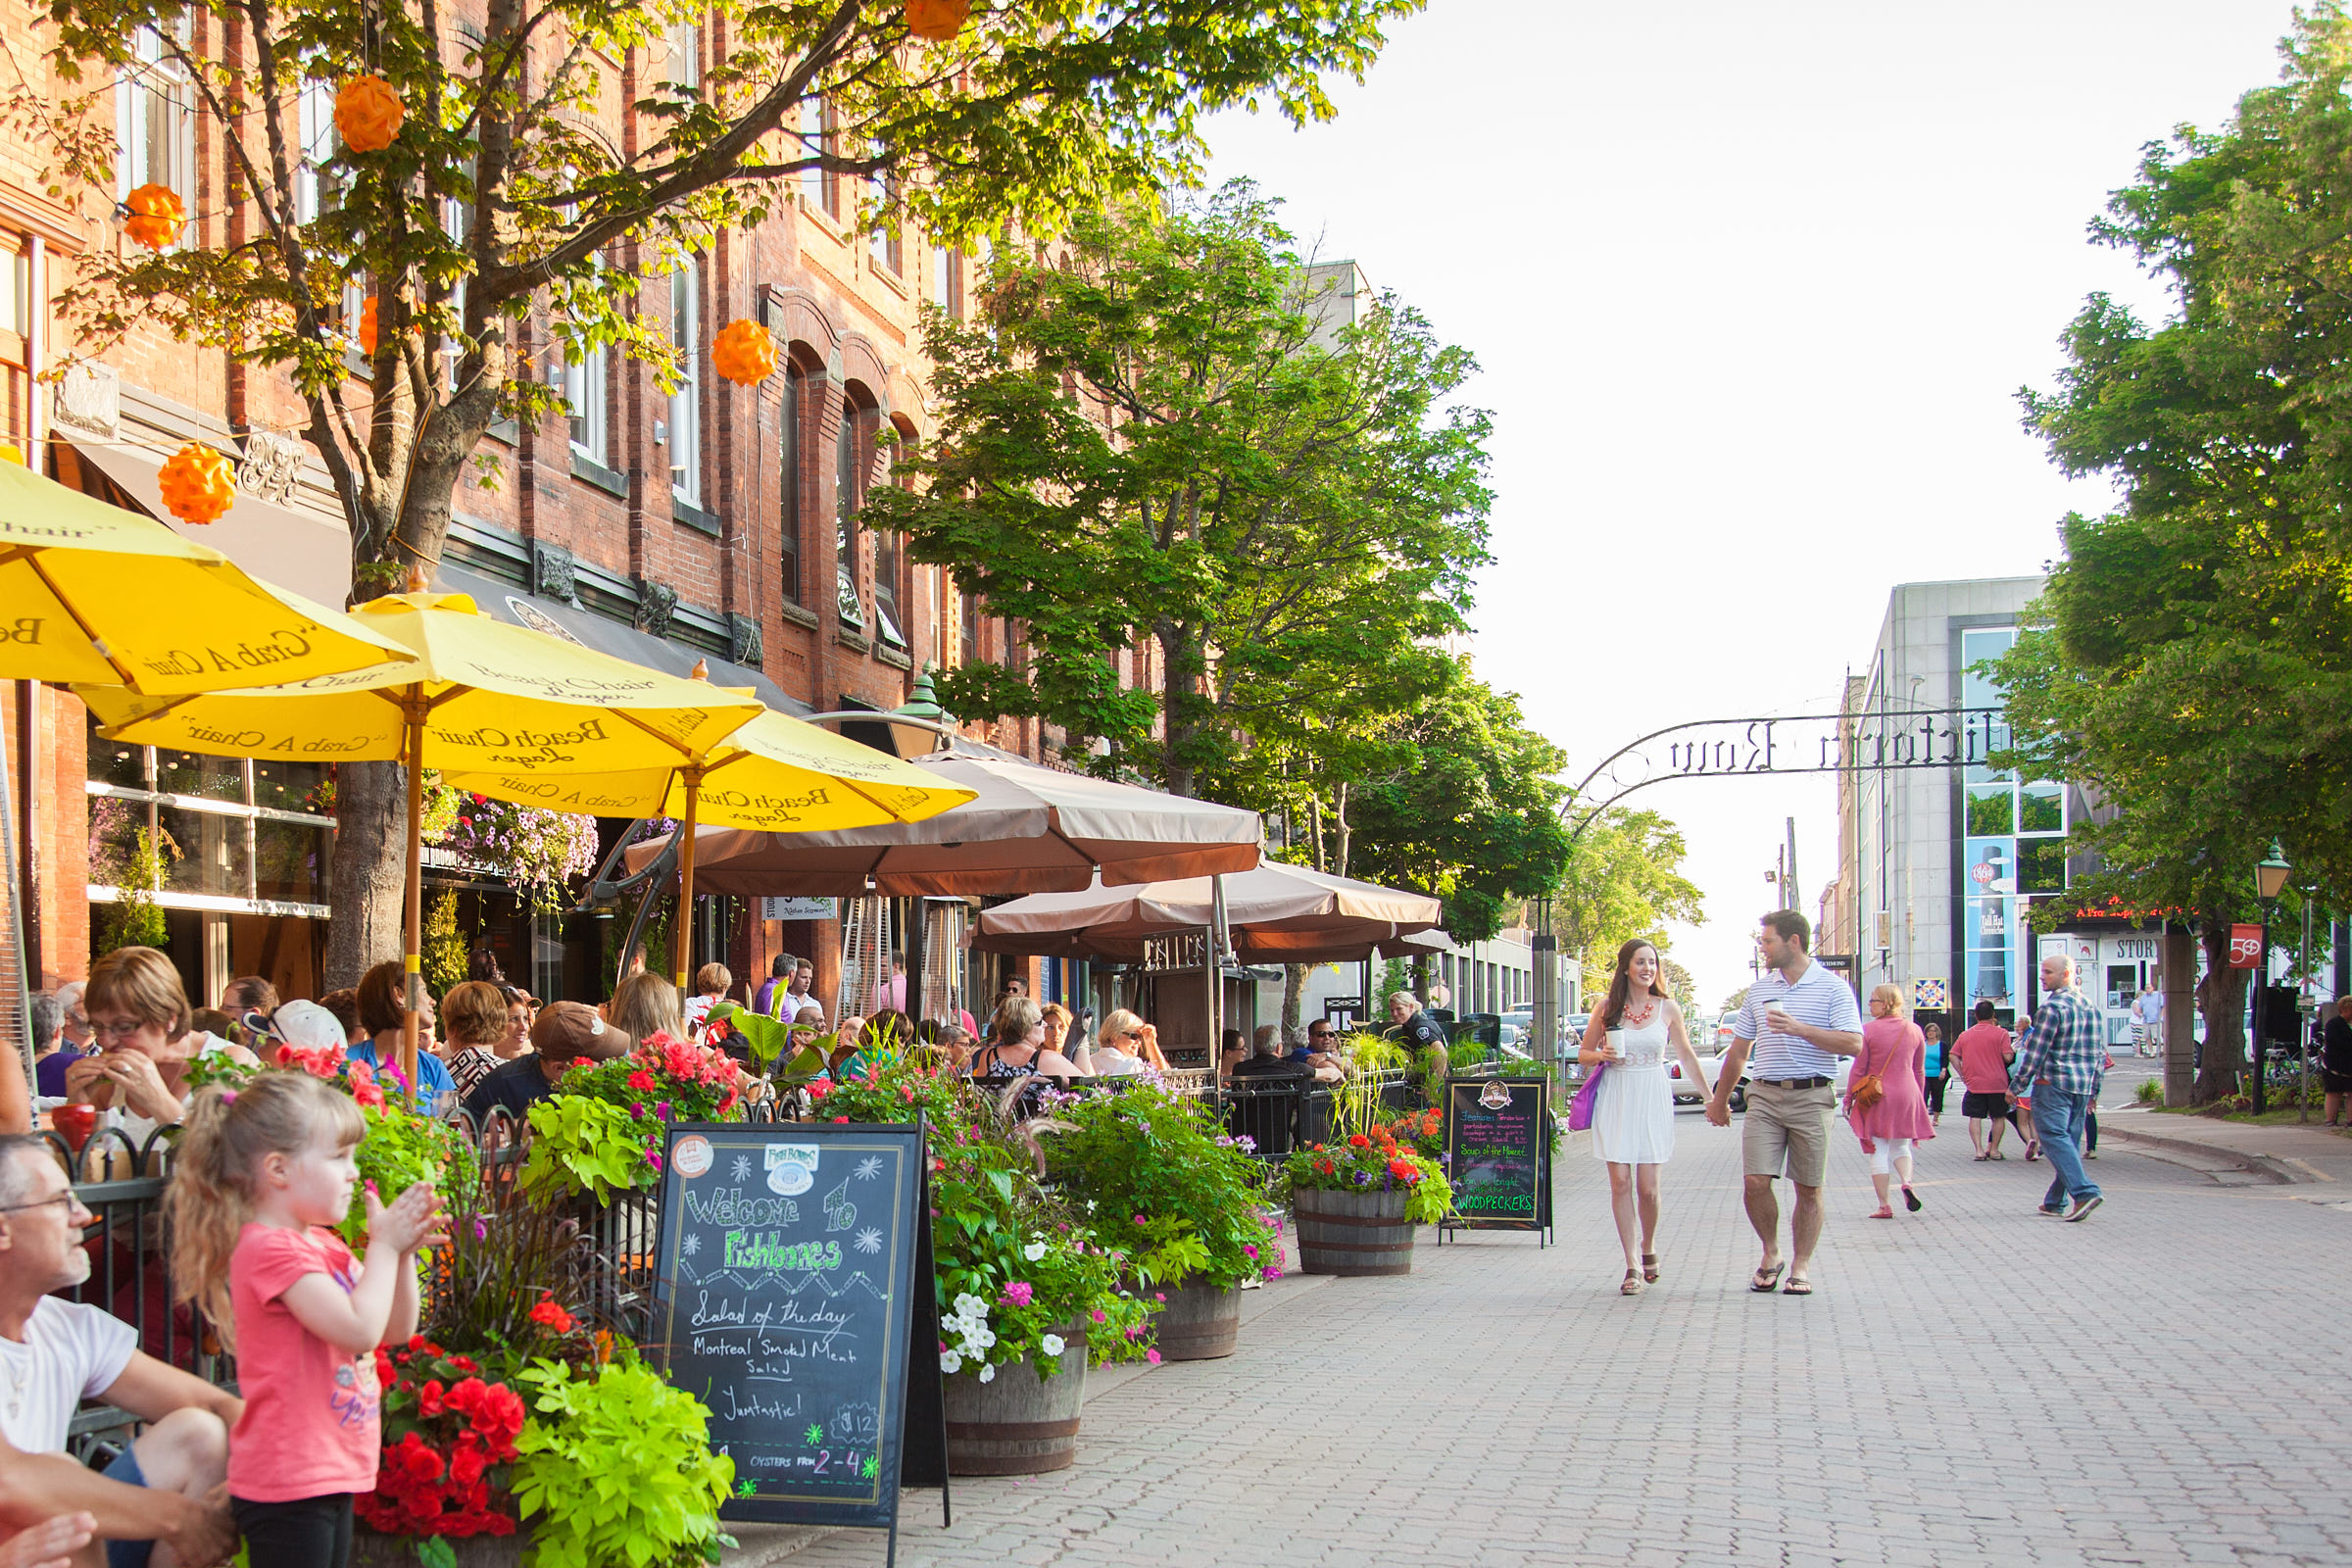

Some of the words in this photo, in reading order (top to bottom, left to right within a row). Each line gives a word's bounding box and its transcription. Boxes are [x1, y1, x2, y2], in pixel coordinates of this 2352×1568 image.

[2117, 939, 2158, 958] STOR
[1460, 1144, 1481, 1156] Soup
[1483, 1145, 1490, 1155] of
[1491, 1145, 1501, 1156] the
[1457, 1195, 1532, 1211] WOODPECKERS
[723, 1228, 844, 1271] Fishbones
[691, 1289, 748, 1327] Salad
[752, 1301, 773, 1339] of
[780, 1298, 808, 1324] the
[808, 1299, 856, 1344] day
[694, 1336, 752, 1356] Montreal
[760, 1339, 807, 1358] Smoked
[811, 1341, 858, 1364] Meat
[746, 1359, 790, 1375] Salad
[750, 1455, 792, 1467] OYSTERS
